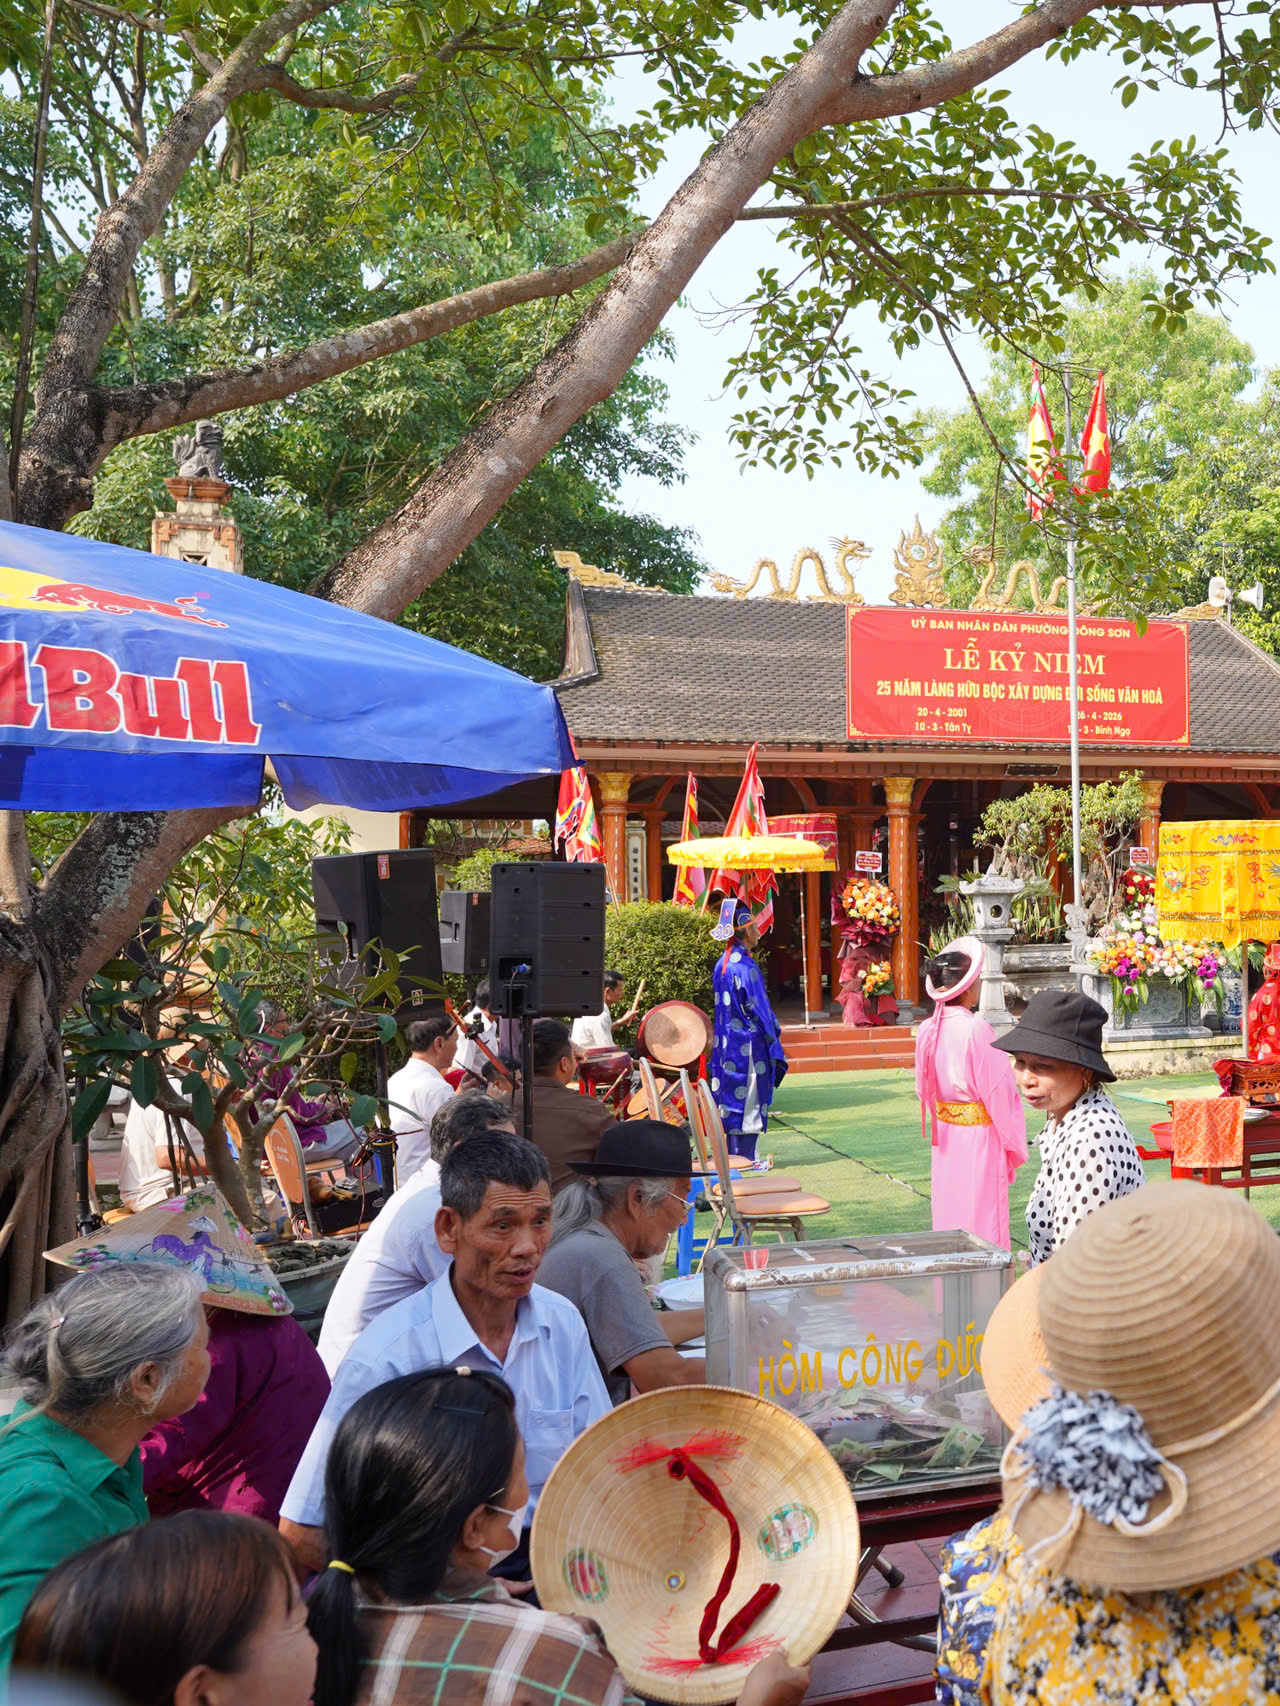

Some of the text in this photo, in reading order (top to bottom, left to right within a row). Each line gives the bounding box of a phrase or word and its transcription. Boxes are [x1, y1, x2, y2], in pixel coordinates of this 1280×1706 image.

[911, 616, 926, 629] UỶ
[930, 619, 954, 630] BAN
[957, 619, 990, 632] NHÂN
[993, 620, 1017, 633] DÂN
[1021, 622, 1069, 635] PHƯỜNG
[1108, 628, 1131, 638] SƠN
[944, 637, 980, 670] LỄ
[989, 642, 1027, 672] KỶ
[30, 643, 262, 746] Bull
[877, 680, 891, 696] 25
[894, 678, 922, 696] NĂM
[924, 679, 954, 698] LÀNG
[957, 680, 980, 698] HỮU
[983, 681, 1005, 702] BỘC
[1008, 682, 1030, 700] XÂY
[1032, 684, 1062, 704] DỰNG
[1087, 683, 1115, 703] SỐNG
[1118, 686, 1139, 704] VĂN
[1142, 687, 1163, 704] HOÁ
[935, 707, 941, 717] 4
[947, 707, 967, 717] 2001
[1091, 711, 1097, 720] 4
[1103, 711, 1123, 721] 2026
[915, 721, 926, 731] 10
[932, 722, 938, 731] 3
[944, 722, 960, 732] Tân
[1083, 725, 1089, 734] 3
[758, 1337, 823, 1397] HÒM
[837, 1331, 924, 1390] CÔNG
